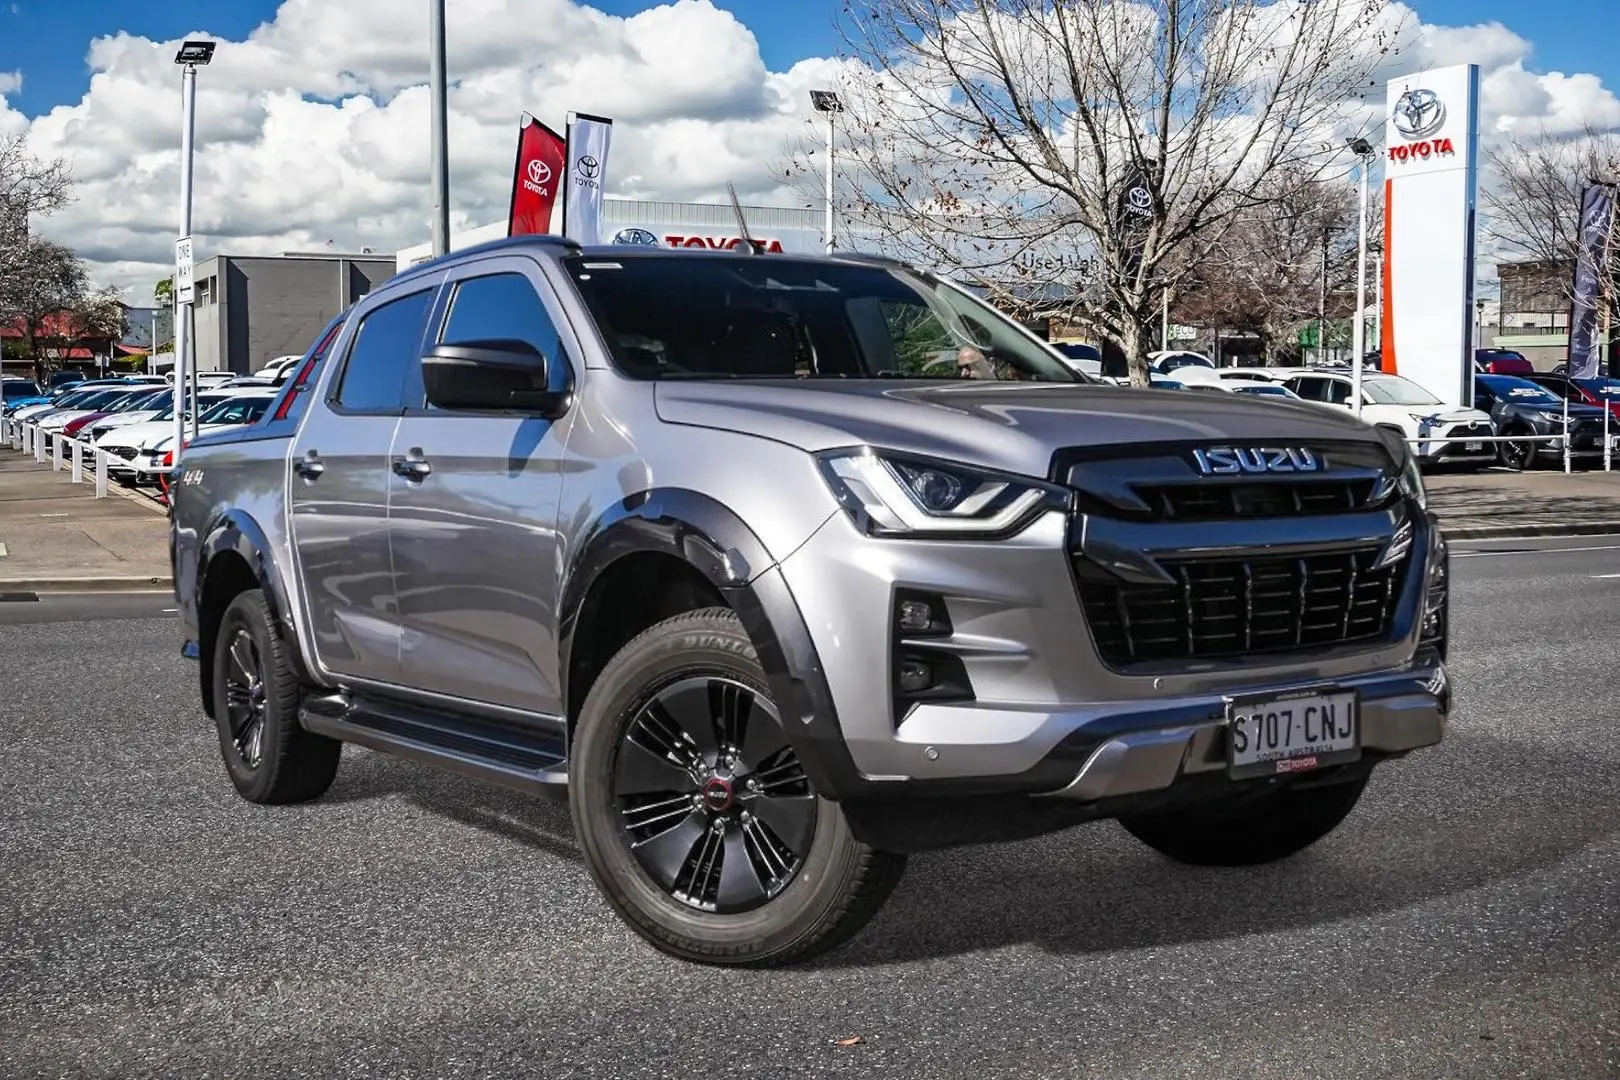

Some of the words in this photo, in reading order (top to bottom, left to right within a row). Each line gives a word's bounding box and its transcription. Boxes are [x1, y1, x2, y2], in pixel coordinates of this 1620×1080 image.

[1388, 138, 1454, 161] TOYOTA
[523, 179, 548, 197] TOYOTA
[574, 177, 599, 190] TOYOTA
[178, 244, 190, 261] ONE
[178, 264, 191, 279] WAY
[1193, 446, 1317, 473] ISUZU
[684, 635, 760, 664] DUNLO
